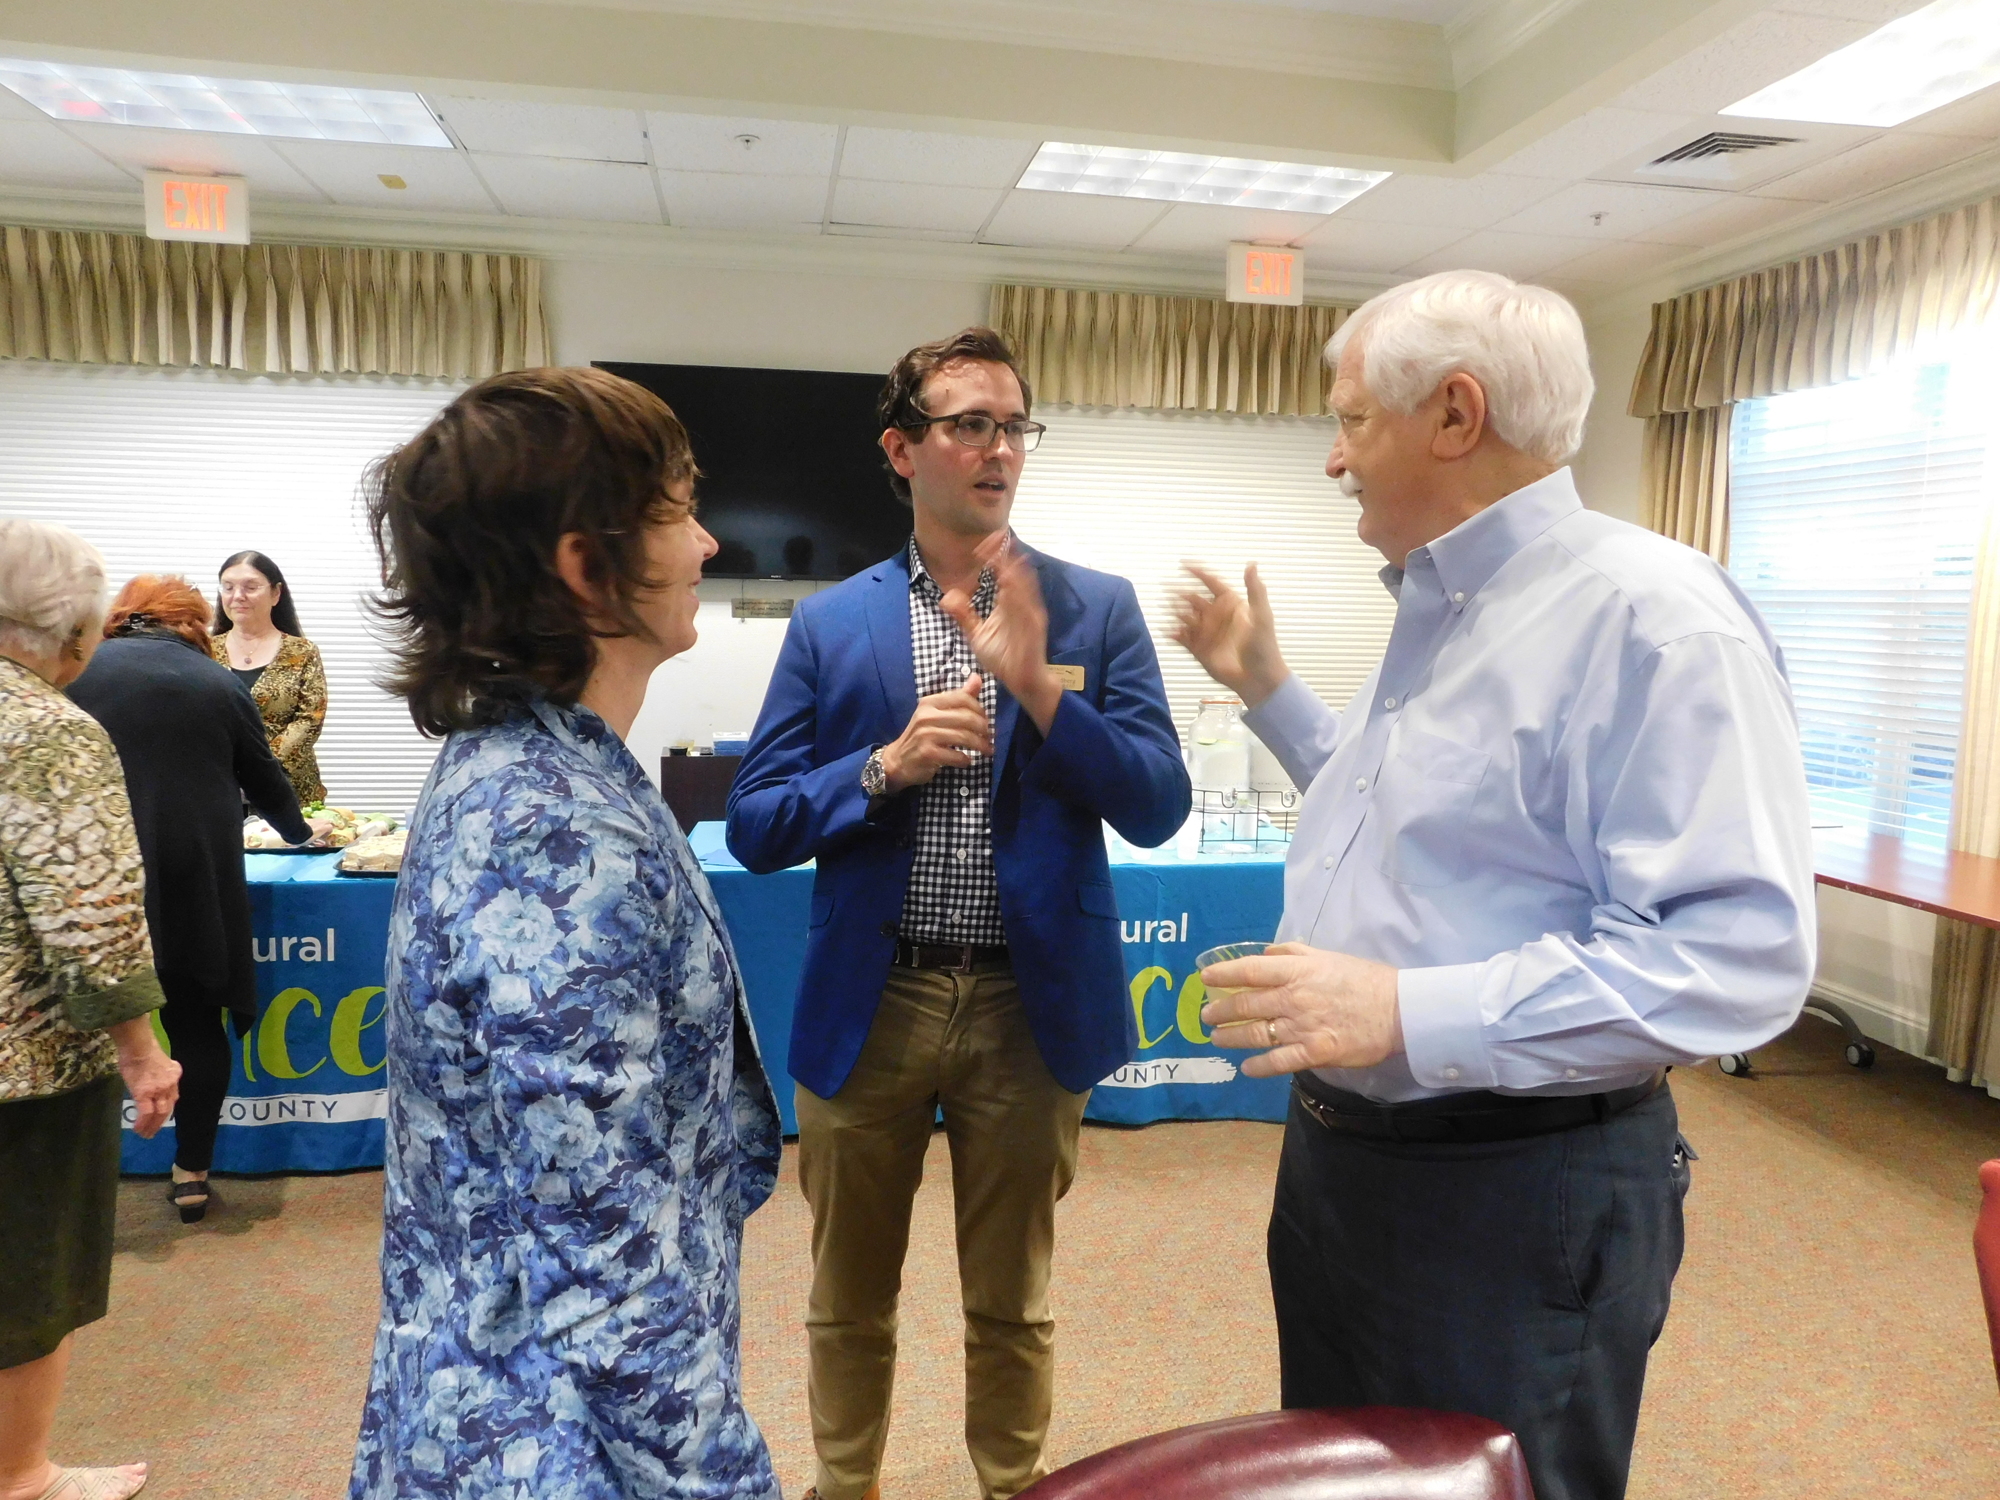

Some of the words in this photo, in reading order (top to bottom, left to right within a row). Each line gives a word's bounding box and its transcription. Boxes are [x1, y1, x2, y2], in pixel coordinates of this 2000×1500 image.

[163, 180, 230, 232] EXIT
[1245, 251, 1295, 297] EXIT
[251, 928, 335, 962] ural
[1120, 912, 1188, 943] ural
[1129, 965, 1213, 1049] ce
[243, 986, 388, 1082] ce
[1113, 1063, 1180, 1083] UNTY
[219, 1100, 338, 1121] OUNTY
